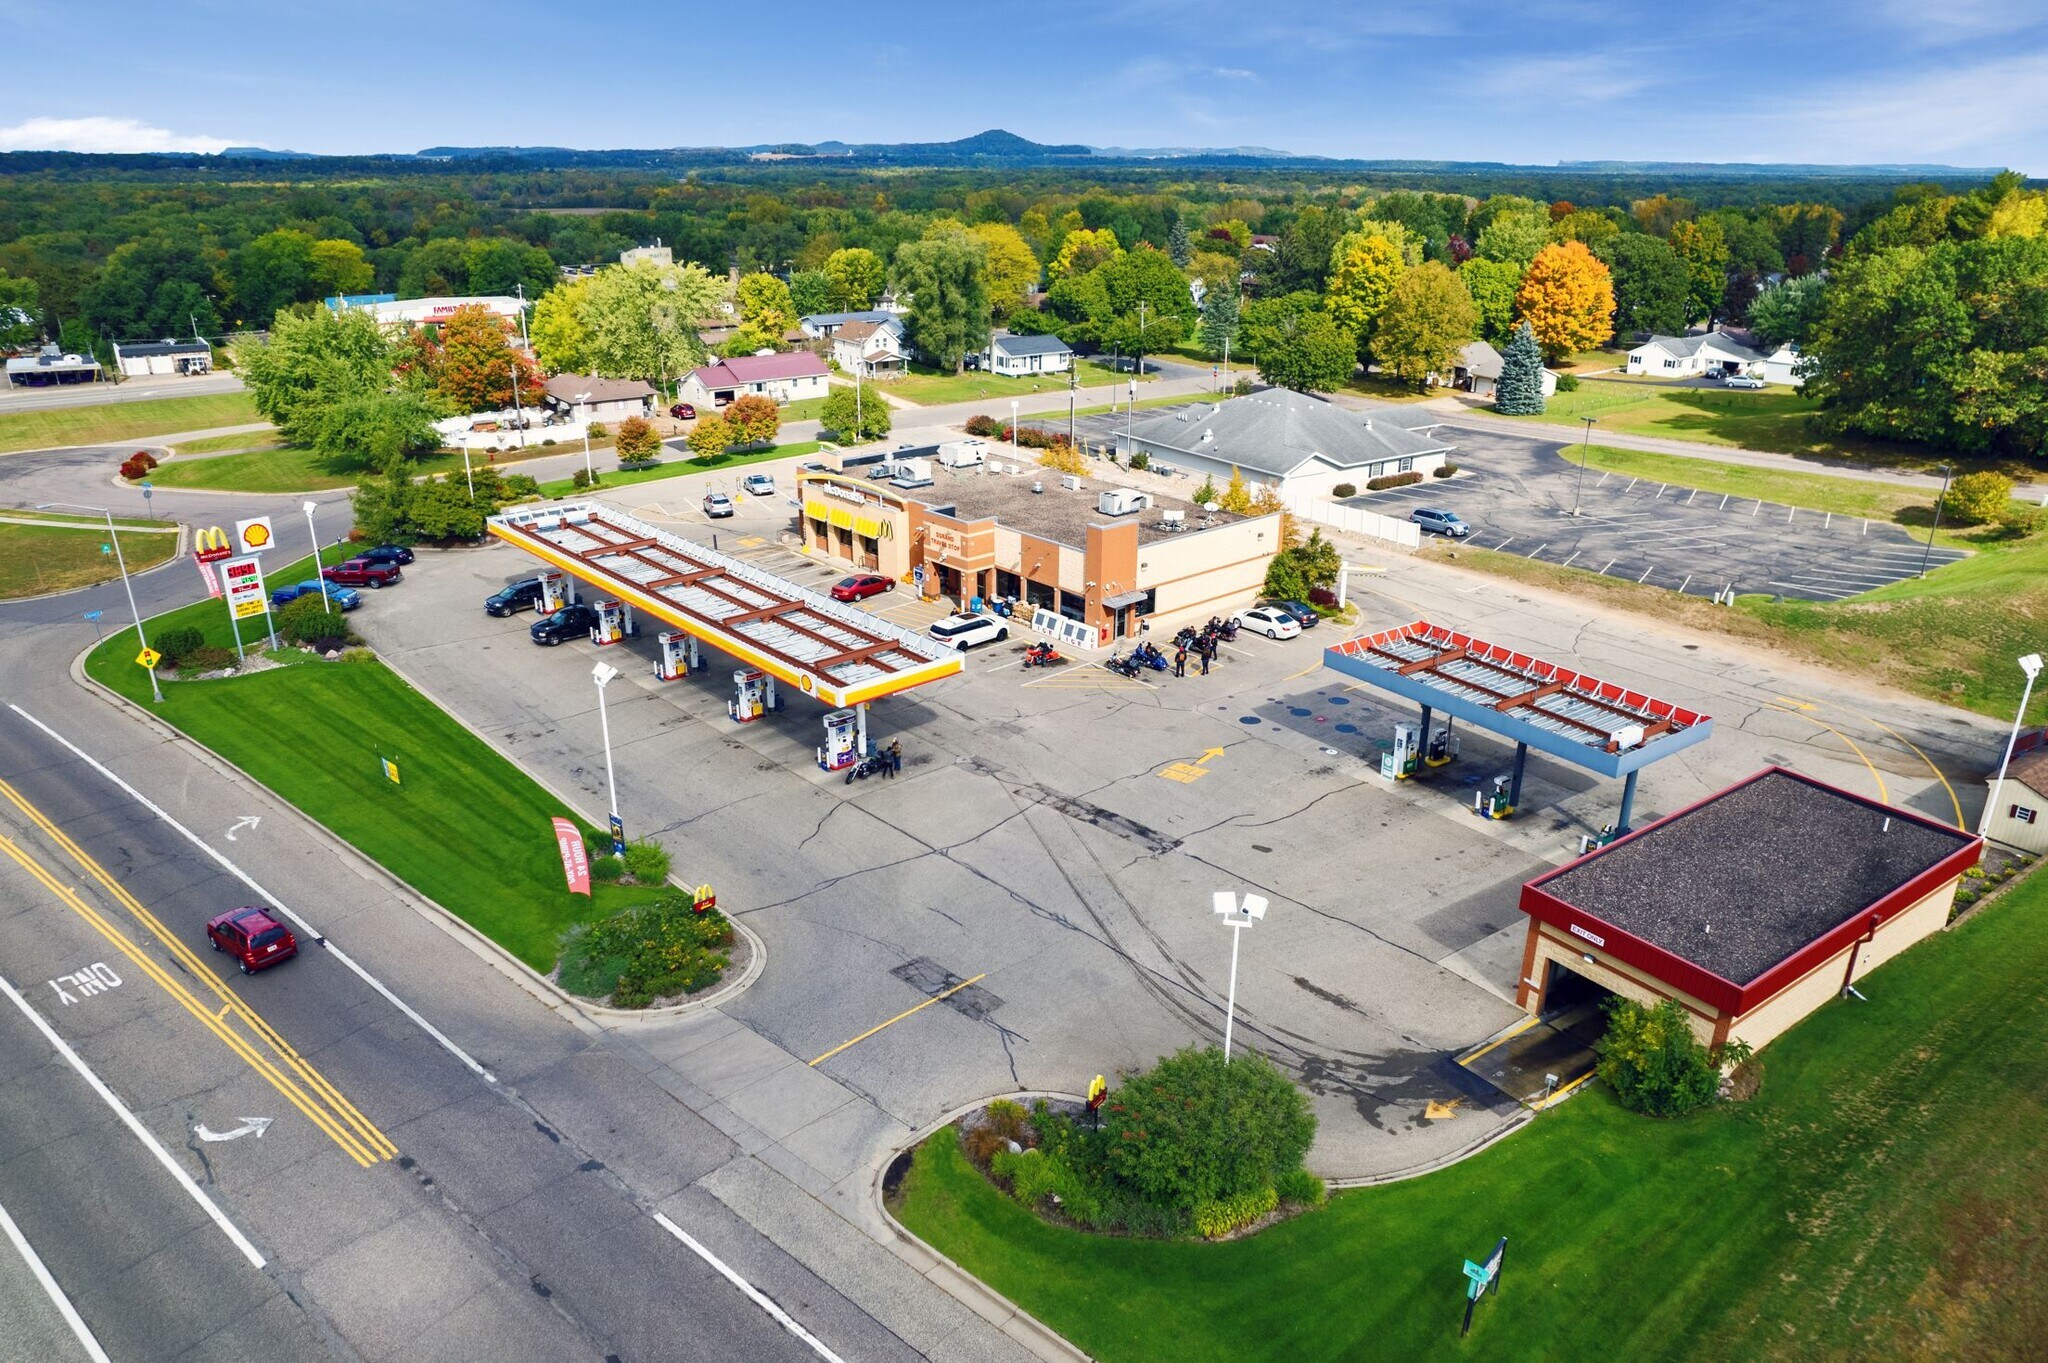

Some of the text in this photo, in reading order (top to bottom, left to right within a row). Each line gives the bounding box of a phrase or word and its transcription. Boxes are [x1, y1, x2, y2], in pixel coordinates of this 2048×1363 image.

[433, 305, 457, 314] FAMILY
[936, 532, 954, 542] DURAND
[948, 543, 960, 552] STOP
[1572, 926, 1603, 943] EXIT ONLY
[48, 962, 123, 1007] ONLY
